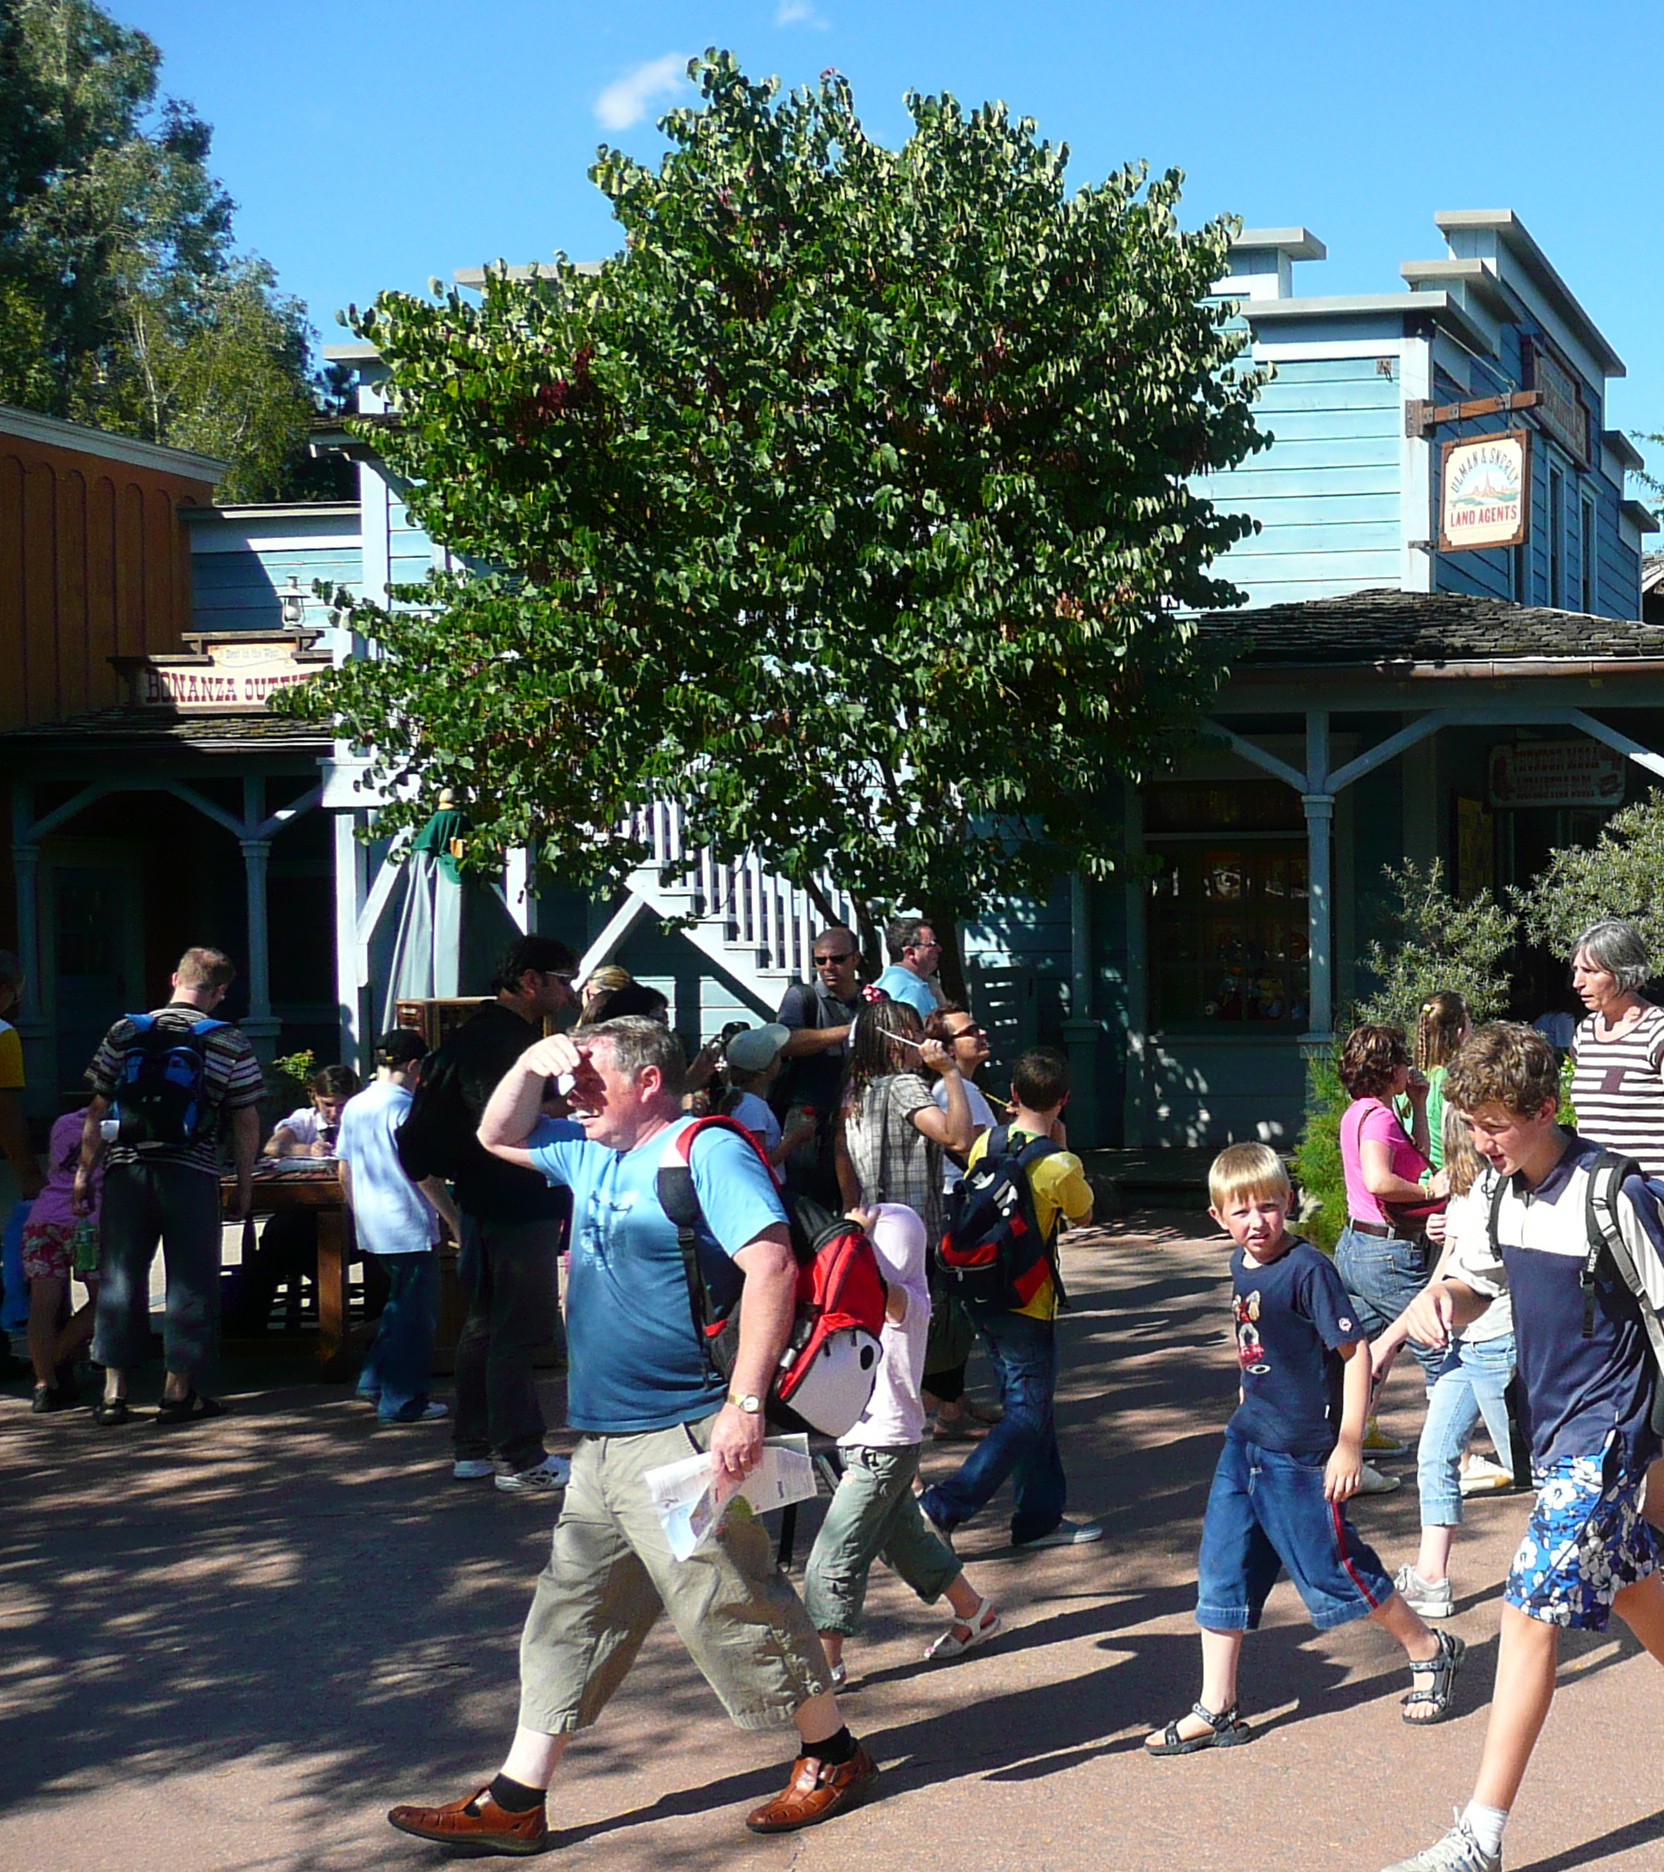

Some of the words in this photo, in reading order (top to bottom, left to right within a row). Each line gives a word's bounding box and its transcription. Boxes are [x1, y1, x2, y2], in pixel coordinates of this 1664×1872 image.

[1450, 510, 1476, 528] LAND
[1478, 504, 1518, 524] AGENTS
[146, 669, 238, 703] BONANZA
